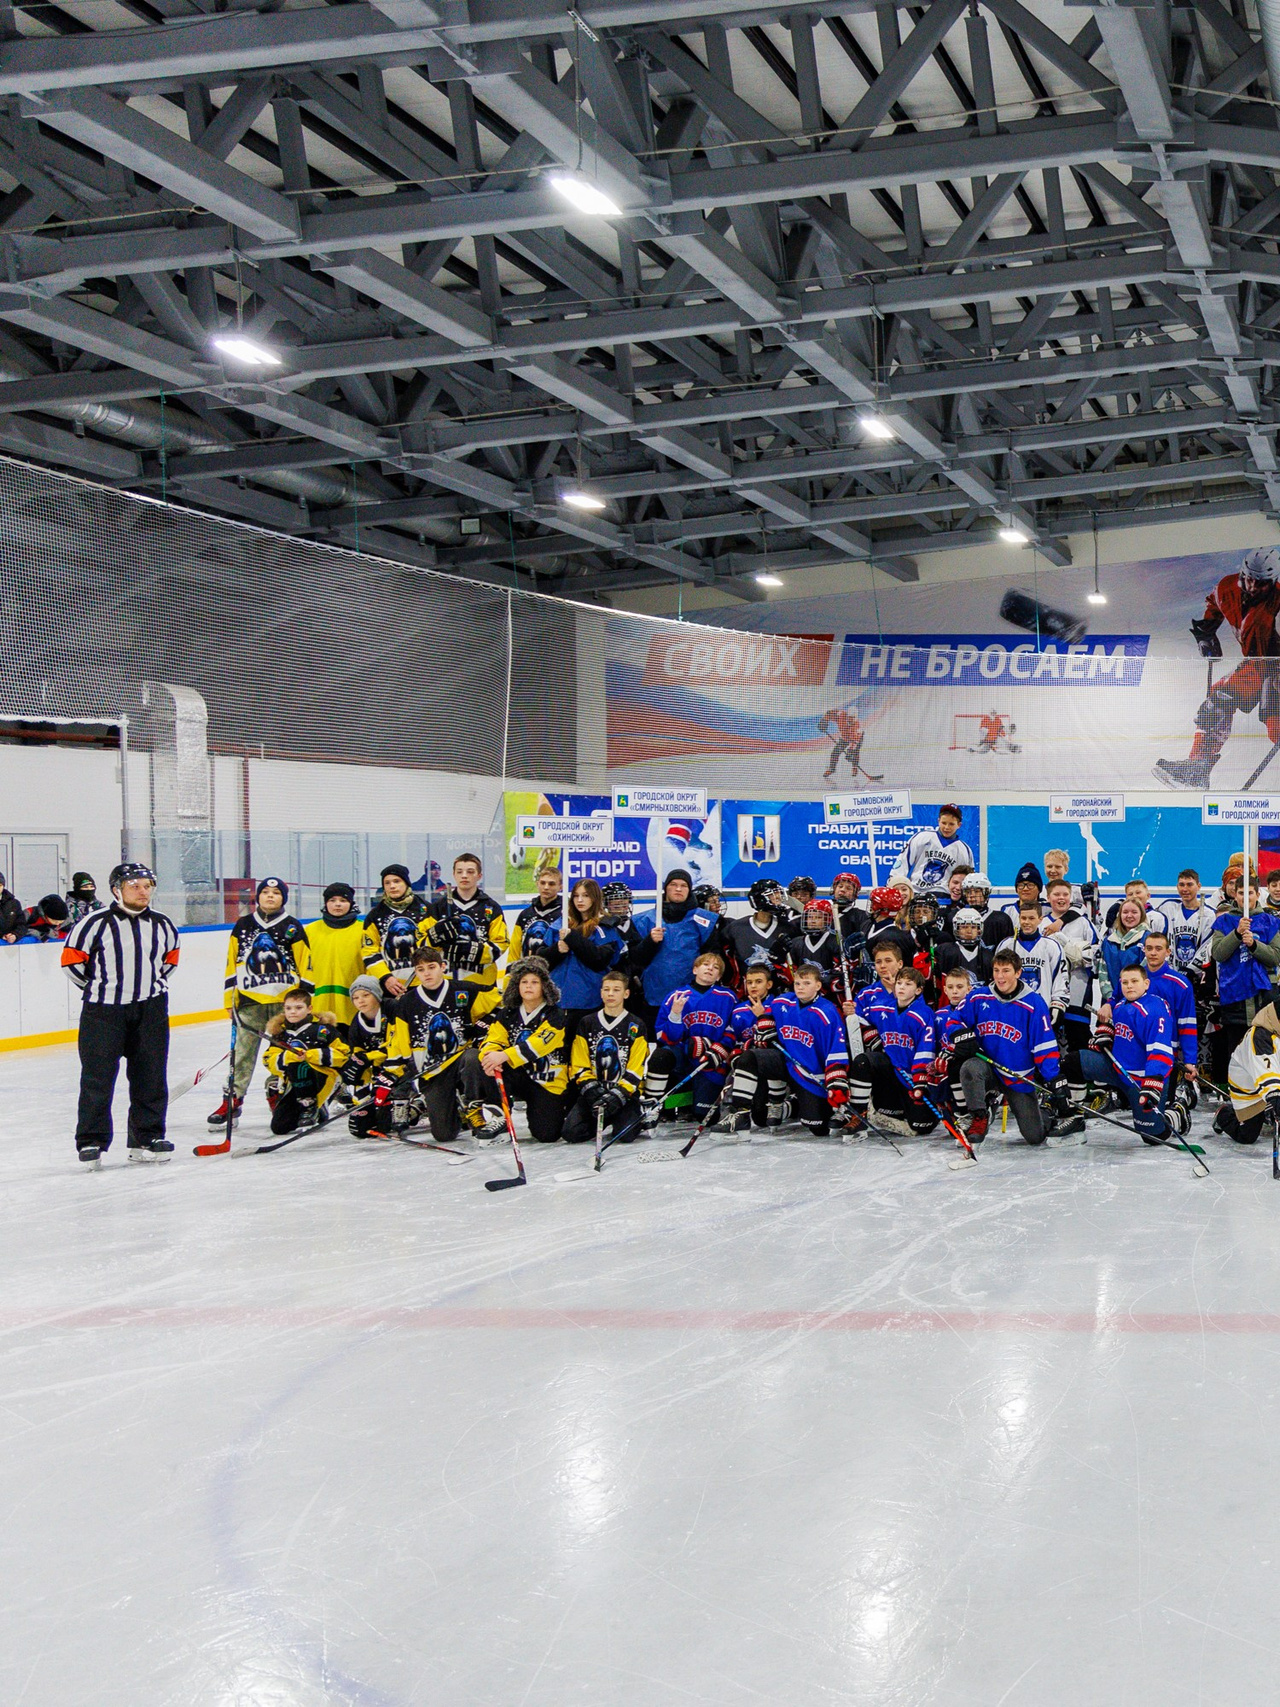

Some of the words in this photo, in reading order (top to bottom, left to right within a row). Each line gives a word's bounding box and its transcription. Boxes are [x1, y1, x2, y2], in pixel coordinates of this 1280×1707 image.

[662, 642, 799, 678] СВОИХ
[859, 643, 912, 679] НЕ
[925, 643, 1126, 679] БРОСАЕМ
[633, 791, 674, 802] ГОРОДСКОЙ
[676, 792, 698, 802] ОКРУГ
[853, 794, 893, 806] ТЫМОВСКИЙ
[630, 802, 702, 813] «СМИРНЫХОВСКИЙ»
[1071, 798, 1112, 807] ПОРОНАЙСКИЙ
[1233, 799, 1269, 808] ХОЛМСКИЙ
[844, 806, 882, 817] ГОРОДСКОЙ
[883, 805, 903, 815] ОКРУГ
[1066, 808, 1099, 818] ГОРОДСКОЙ
[1100, 808, 1118, 817] ОКРУГ
[1221, 810, 1260, 820] ГОРОДСКОЙ
[1261, 811, 1280, 820] ОКРУГ
[538, 820, 580, 832] ГОРОДСКОЙ
[582, 822, 605, 831] ОКРУГ
[547, 832, 595, 842] «ОХИНСКИЙ»
[568, 860, 641, 878] СПОРТ
[1263, 1057, 1271, 1069] 7
